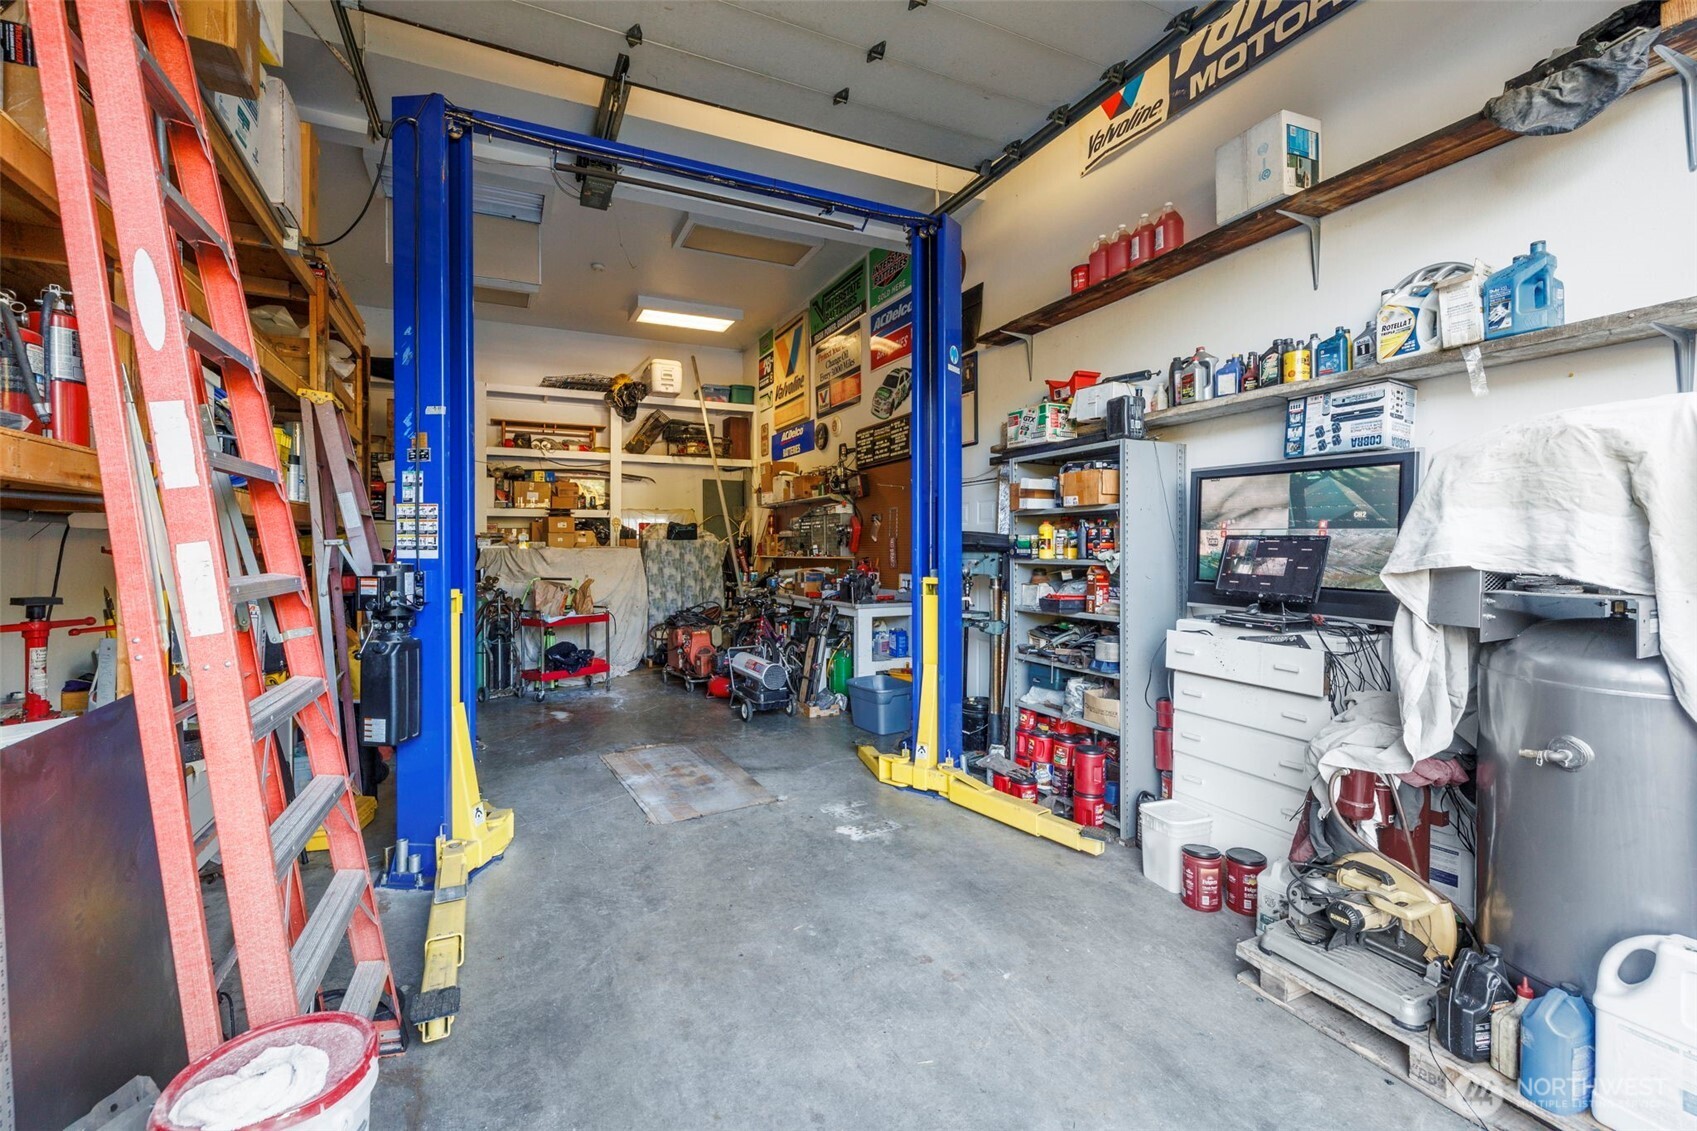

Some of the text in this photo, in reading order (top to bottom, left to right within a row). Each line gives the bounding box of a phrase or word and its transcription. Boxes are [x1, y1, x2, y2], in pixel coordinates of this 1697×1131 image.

[1088, 99, 1163, 159] Valvoline
[878, 279, 907, 302] SOLD HERE
[1381, 319, 1407, 332] ROTELLA
[775, 375, 804, 402] Valvoline
[1023, 415, 1036, 423] GTX
[781, 426, 804, 442] ACDelco
[1351, 435, 1382, 448] COBRA
[1391, 436, 1411, 449] COBRA
